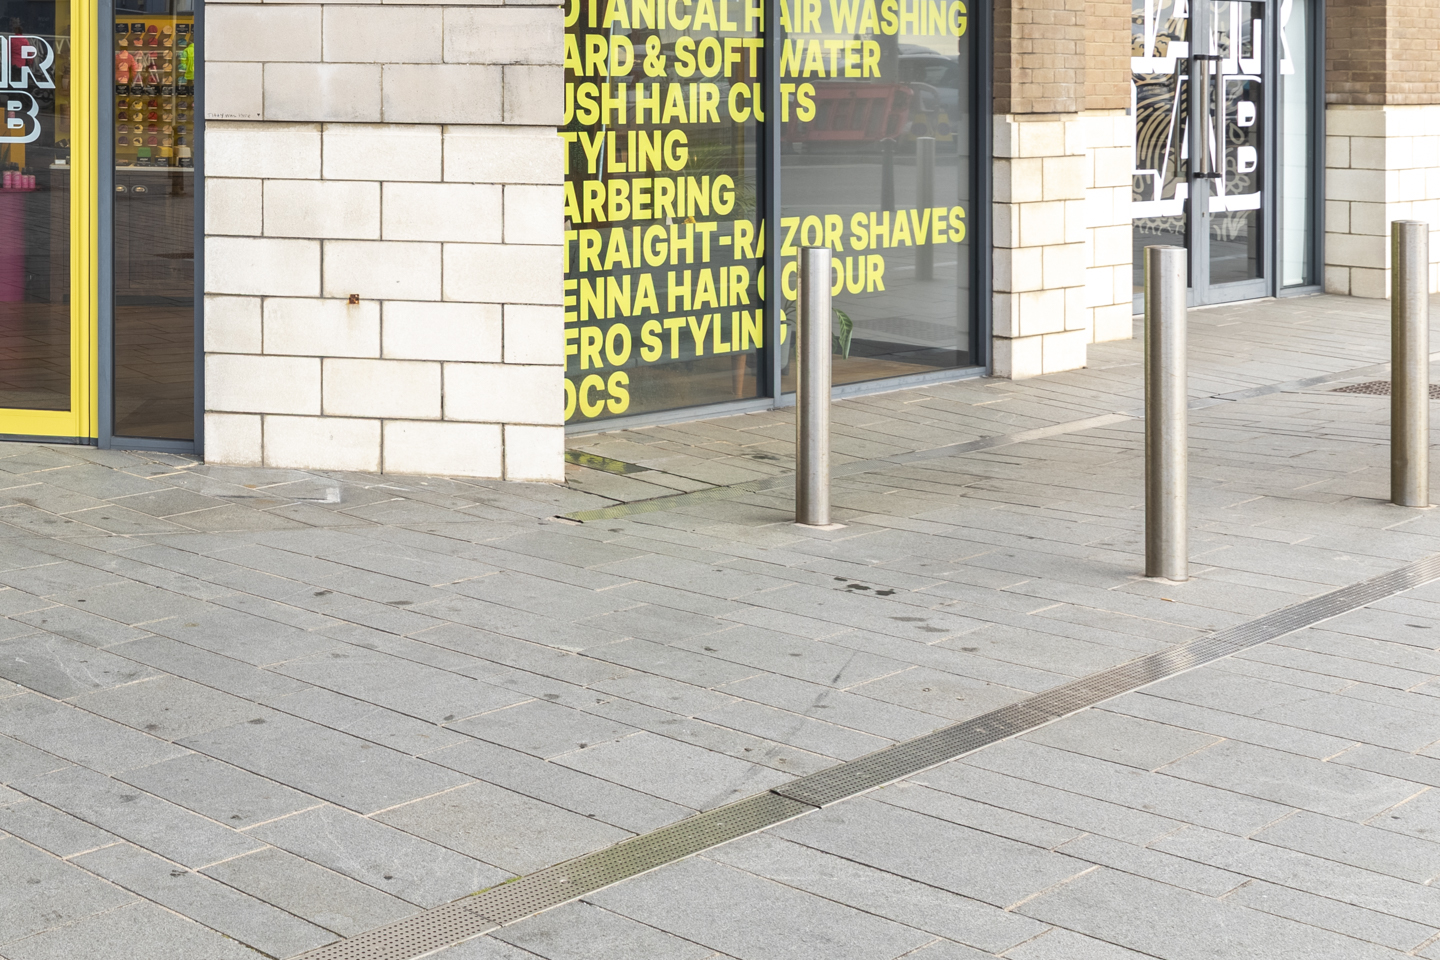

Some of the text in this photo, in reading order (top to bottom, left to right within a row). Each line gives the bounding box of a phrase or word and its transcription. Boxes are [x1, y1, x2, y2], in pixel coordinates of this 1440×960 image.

[642, 34, 668, 78] &
[673, 35, 765, 78] SOFT
[780, 38, 882, 78] WATER
[635, 82, 721, 125] HAIR
[558, 128, 689, 175] TYLING
[563, 205, 967, 274] TRAIGHT-RZOR SHAVES
[667, 265, 751, 313] HAIR
[757, 253, 886, 302] OOUR
